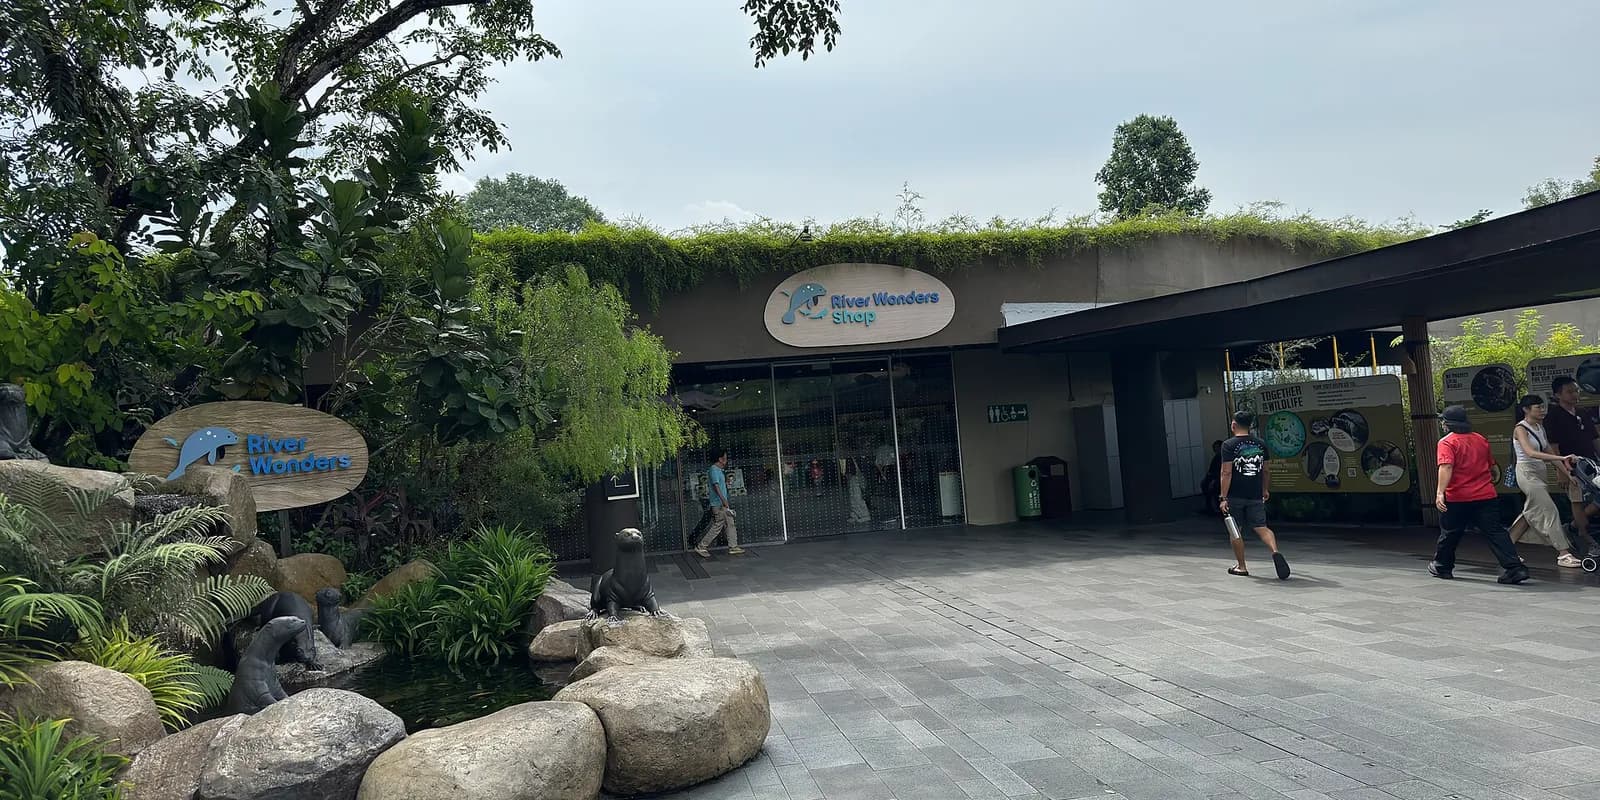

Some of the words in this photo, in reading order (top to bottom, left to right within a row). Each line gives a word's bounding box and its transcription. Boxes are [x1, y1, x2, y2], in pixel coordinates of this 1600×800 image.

[831, 294, 871, 309] River
[873, 290, 939, 306] Wonders
[832, 308, 876, 326] Shop
[1261, 385, 1302, 401] TOGETHER
[1268, 396, 1303, 412] WILDLIFE
[247, 433, 307, 454] River
[249, 452, 352, 476] Wonders
